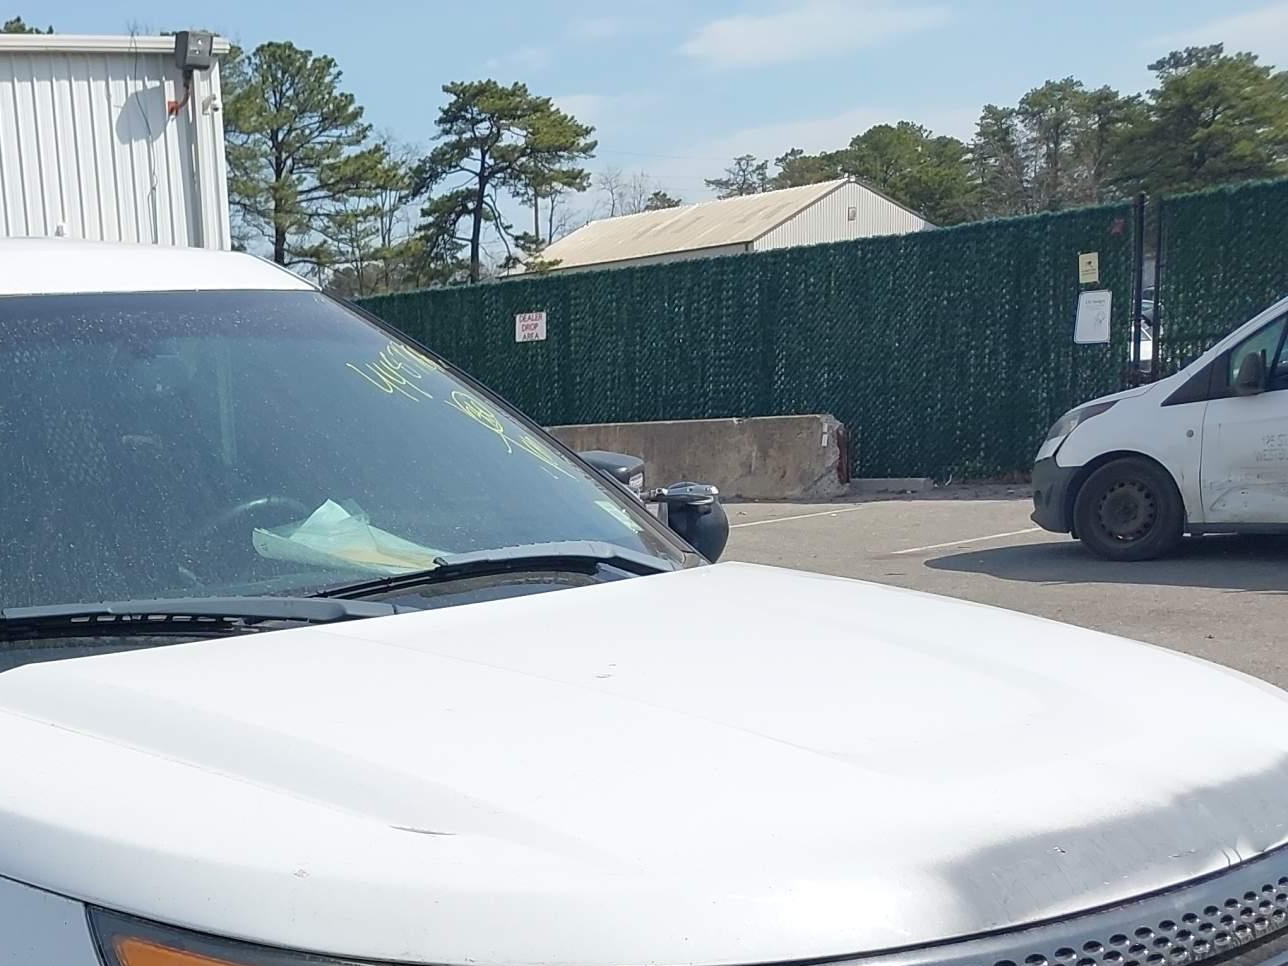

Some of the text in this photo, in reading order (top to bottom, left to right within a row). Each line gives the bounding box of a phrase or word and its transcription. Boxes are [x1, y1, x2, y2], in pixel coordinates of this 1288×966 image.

[519, 313, 543, 322] DEALER
[521, 323, 539, 331] DROP
[522, 332, 540, 340] AREA
